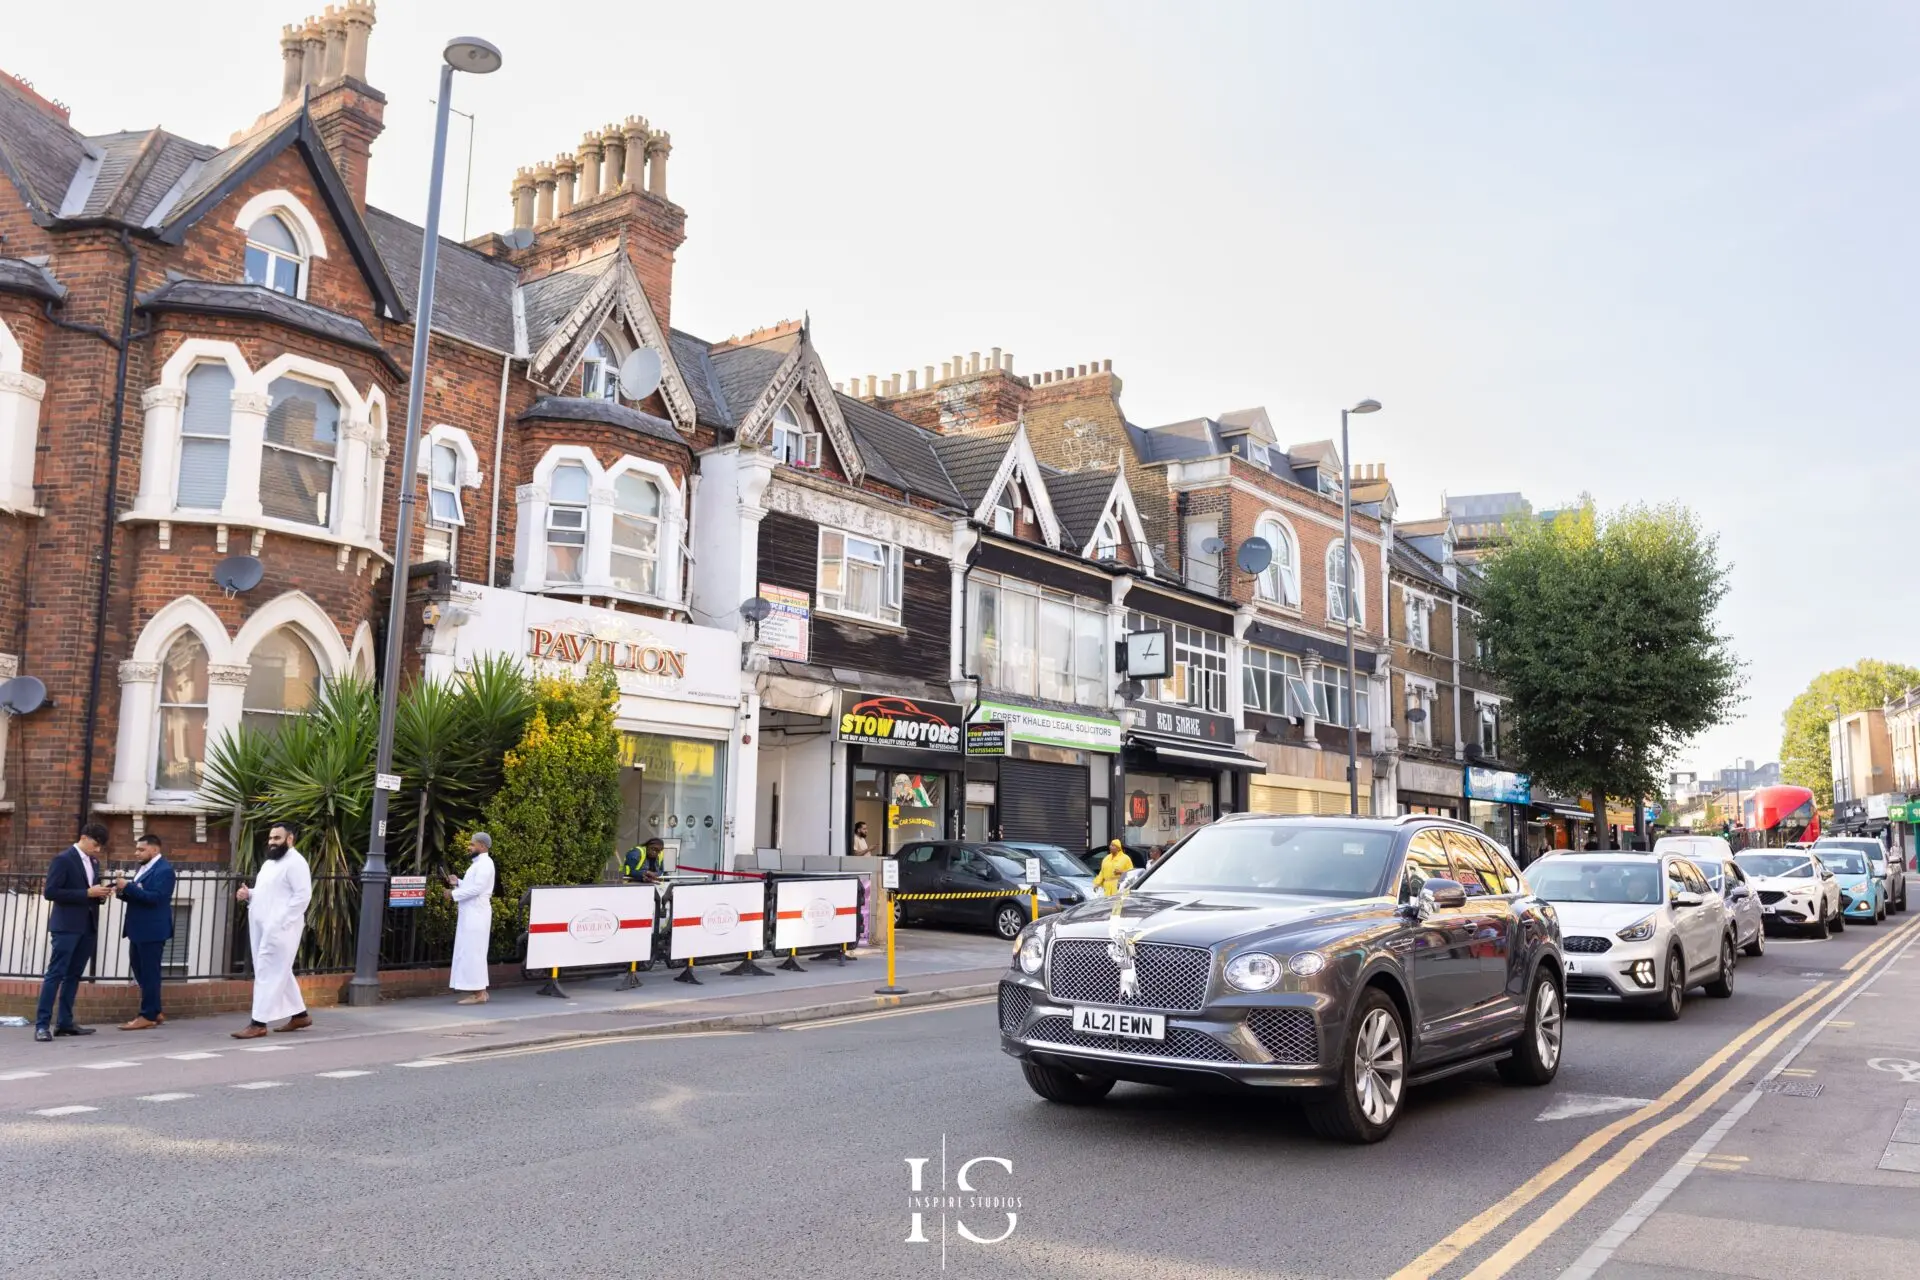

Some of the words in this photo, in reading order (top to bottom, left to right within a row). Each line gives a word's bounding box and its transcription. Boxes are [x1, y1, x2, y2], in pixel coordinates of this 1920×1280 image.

[527, 627, 688, 678] PAVILION
[840, 713, 894, 737] STOW
[893, 719, 960, 744] MOTORS
[992, 711, 1021, 723] FOREST
[1022, 716, 1052, 728] KHALED
[1052, 720, 1074, 732] LEGAL
[1075, 723, 1112, 737] SOLICITORS
[1156, 712, 1173, 731] RED
[878, 737, 896, 745] QUALITY
[899, 818, 908, 826] CAR
[576, 922, 612, 932] PAVILION
[1082, 1011, 1115, 1031] AL21
[1119, 1015, 1153, 1035] EWN
